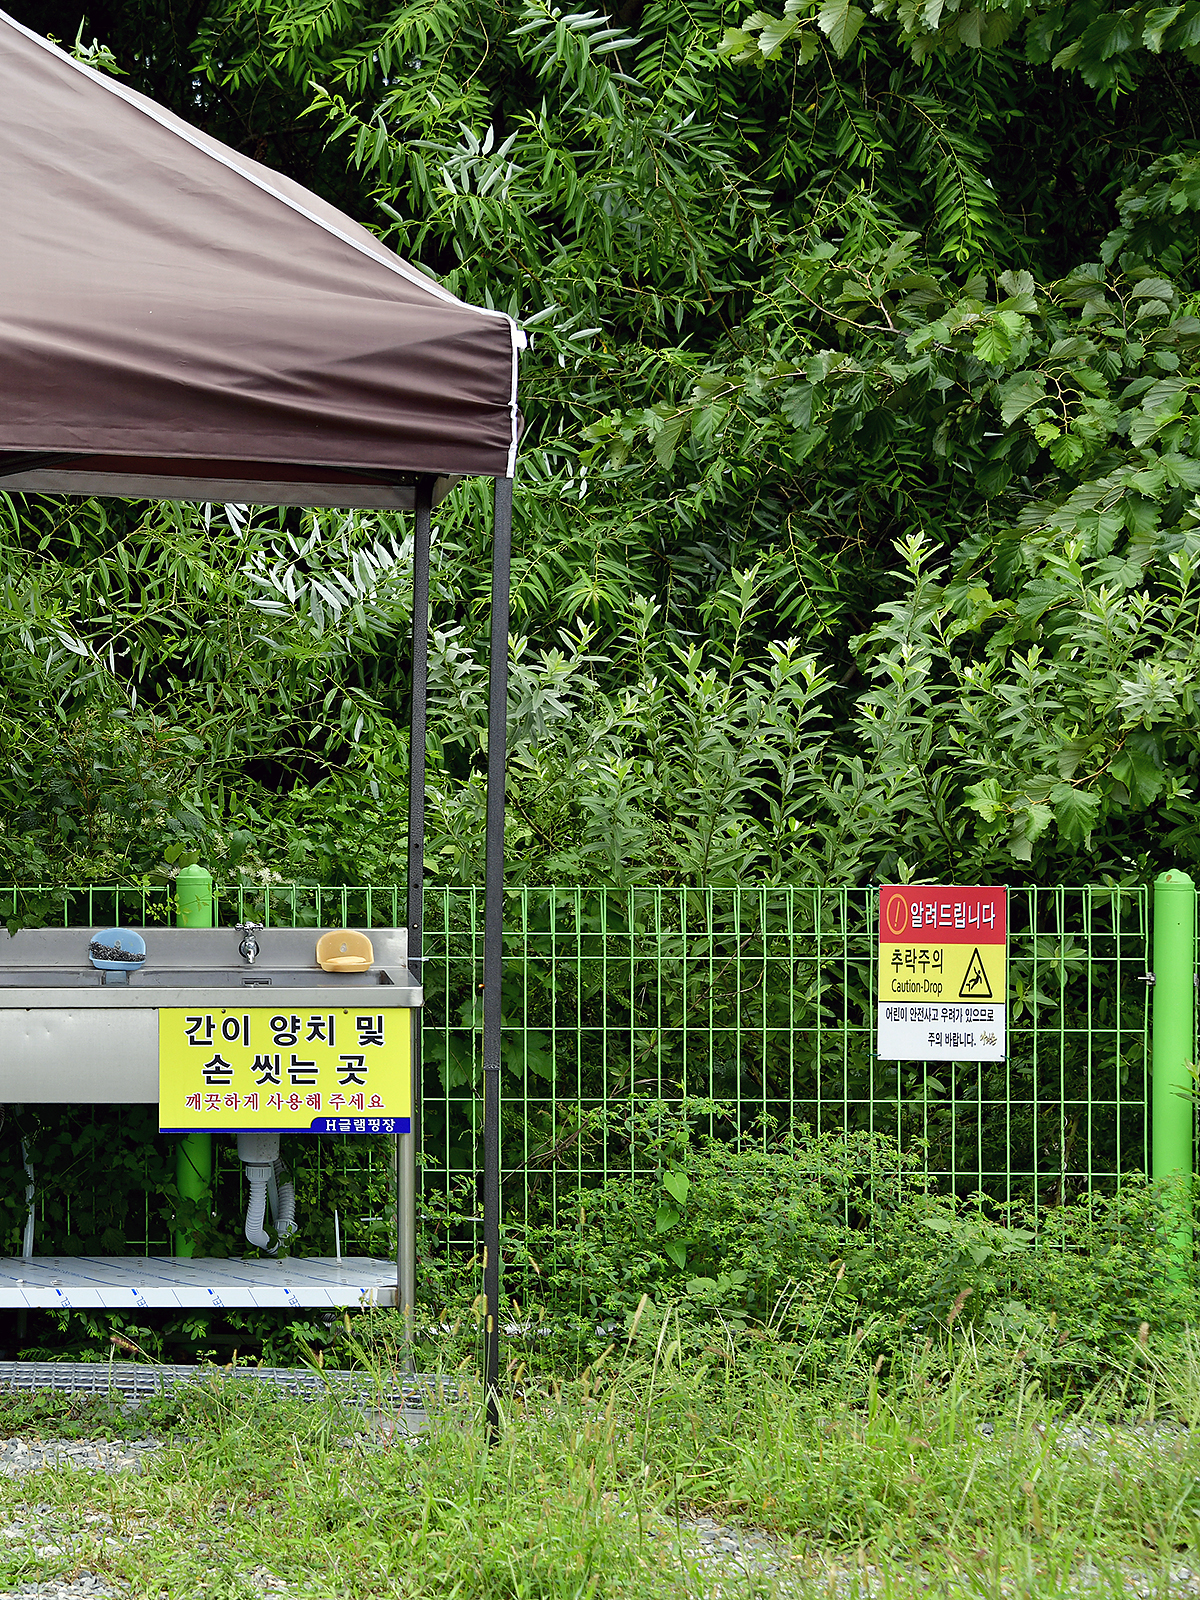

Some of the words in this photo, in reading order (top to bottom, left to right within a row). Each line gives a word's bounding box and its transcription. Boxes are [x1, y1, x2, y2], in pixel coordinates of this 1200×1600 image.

[910, 901, 996, 930] 알려드립니다
[890, 948, 944, 975] 추락주의
[891, 978, 943, 997] Caution-Drop
[885, 1006, 908, 1022] 어린이
[909, 1007, 939, 1022] 안전사고
[940, 1007, 963, 1023] 우려가
[965, 1007, 995, 1023] 있으므로
[184, 1015, 250, 1046] 간이
[269, 1015, 335, 1047] 양치
[355, 1015, 385, 1046] 및
[927, 1032, 943, 1047] 주의
[944, 1032, 977, 1047] 바랍니다.
[202, 1054, 233, 1084] 손
[250, 1054, 318, 1085] 씻는
[336, 1055, 367, 1085] 곳
[185, 1092, 259, 1111] 깨끗하게
[266, 1092, 322, 1111] 사용해
[328, 1093, 385, 1111] 주세요
[325, 1118, 396, 1132] H글램핑장
